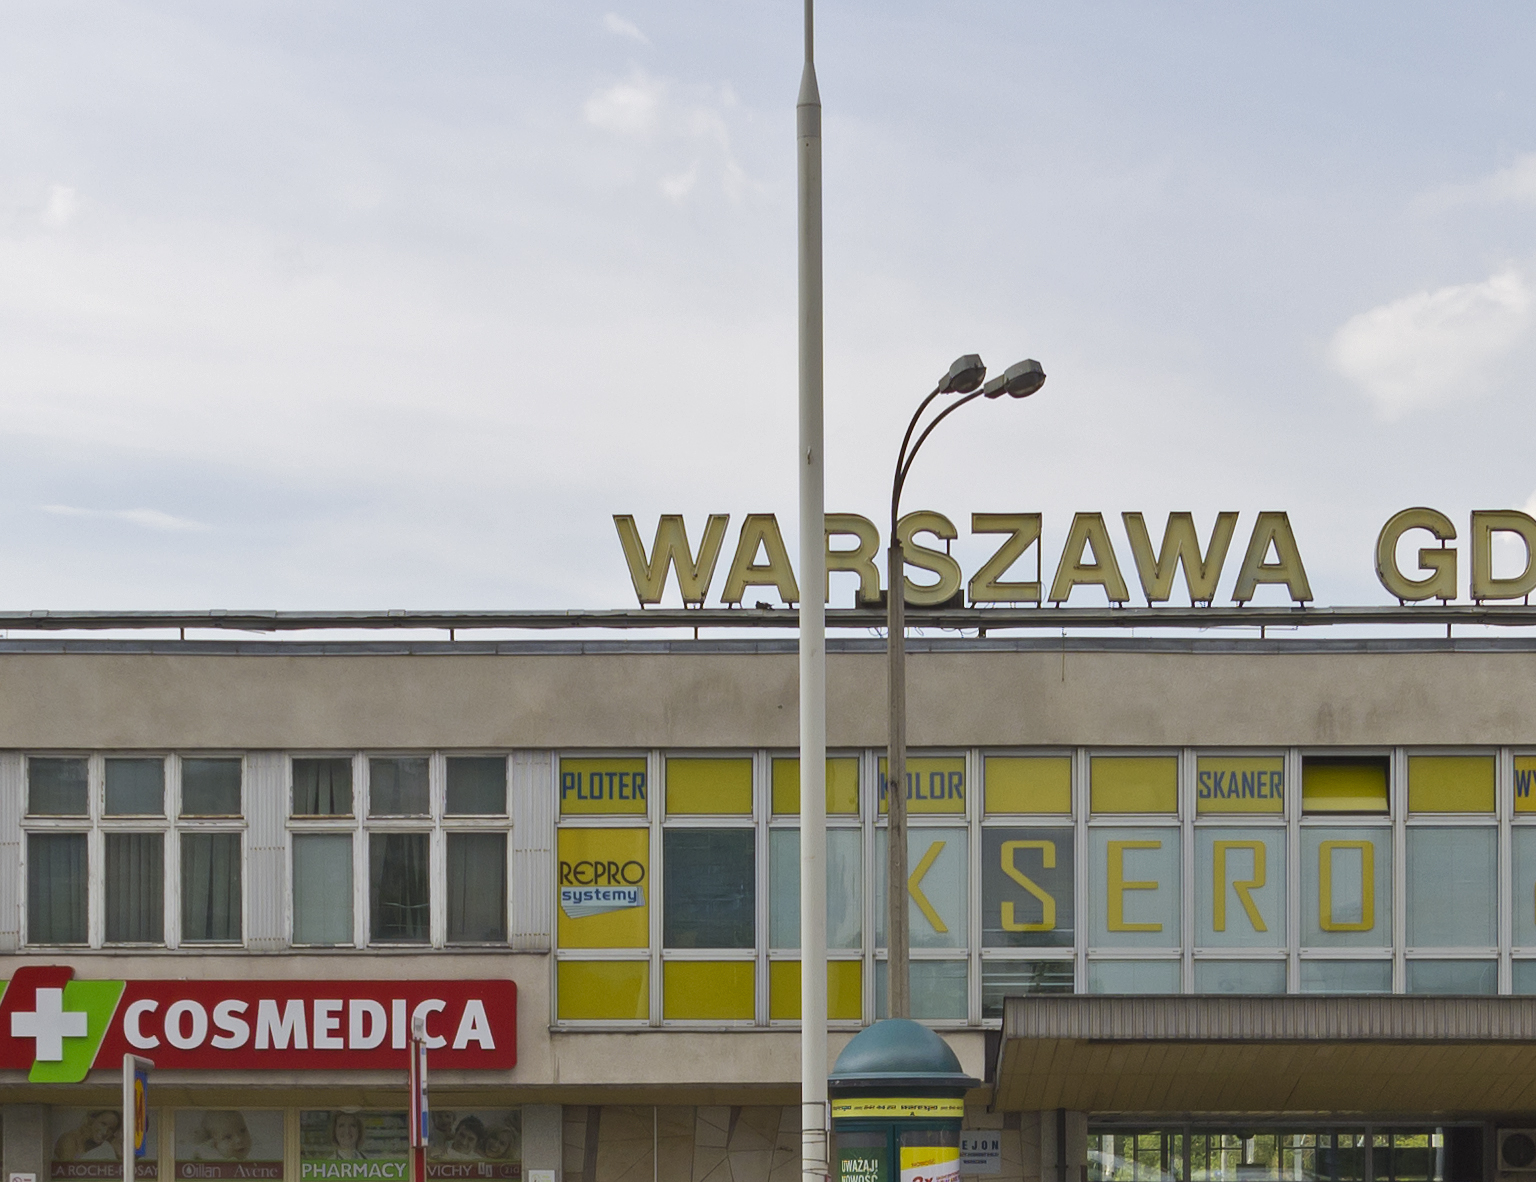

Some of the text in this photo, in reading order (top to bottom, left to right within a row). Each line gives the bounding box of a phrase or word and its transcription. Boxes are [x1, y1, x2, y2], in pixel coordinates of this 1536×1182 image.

[612, 509, 1313, 605] WARSZAWA
[563, 772, 646, 800] PLOTER
[1198, 770, 1284, 800] SKANER
[560, 860, 646, 886] REPRO
[907, 840, 1375, 932] KSERO
[561, 887, 638, 905] systemy
[122, 997, 497, 1052] COSMEDICA
[961, 1139, 999, 1150] EJON
[301, 1162, 407, 1179] PHARMACY
[426, 1164, 474, 1177] VICHY
[841, 1157, 879, 1173] UWAŻAJ!
